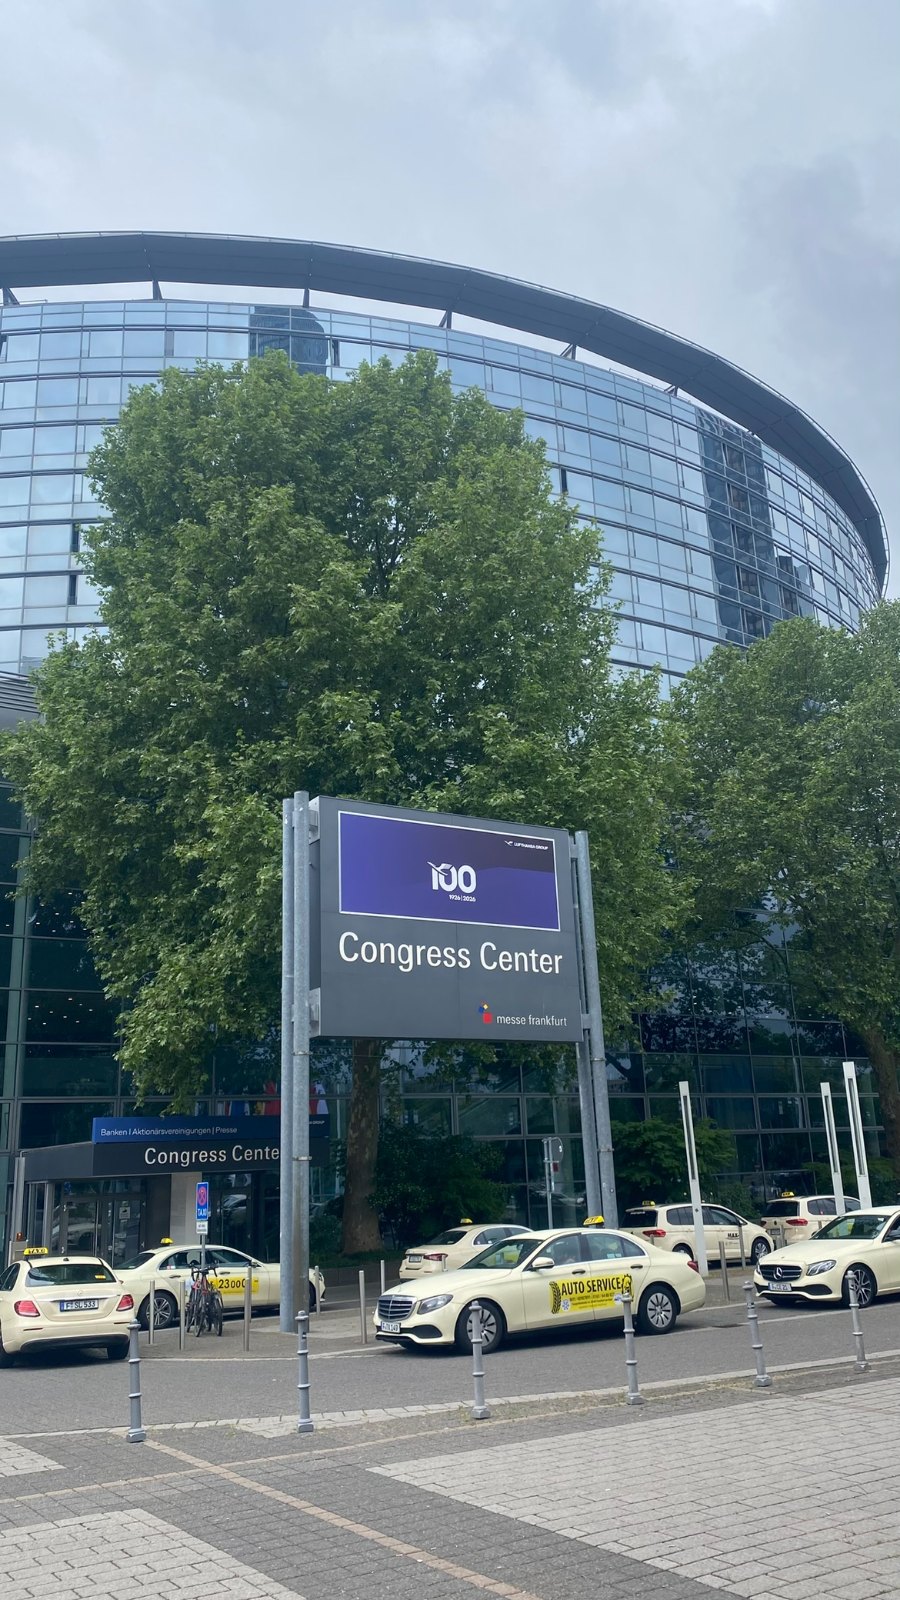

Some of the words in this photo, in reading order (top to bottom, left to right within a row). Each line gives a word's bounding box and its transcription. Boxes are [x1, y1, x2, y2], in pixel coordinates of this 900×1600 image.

[427, 861, 477, 893] 100
[338, 931, 471, 972] Congress
[479, 941, 563, 974] Center
[496, 1015, 526, 1025] messe
[528, 1014, 568, 1026] frankfurt
[100, 1128, 127, 1136] Banken
[131, 1127, 211, 1136] Aktionärsvereinigungen
[215, 1126, 238, 1134] Presse
[144, 1147, 227, 1167] Congress
[232, 1145, 280, 1162] Cente
[561, 1281, 585, 1296] AUTO
[586, 1277, 621, 1293] SERVICE
